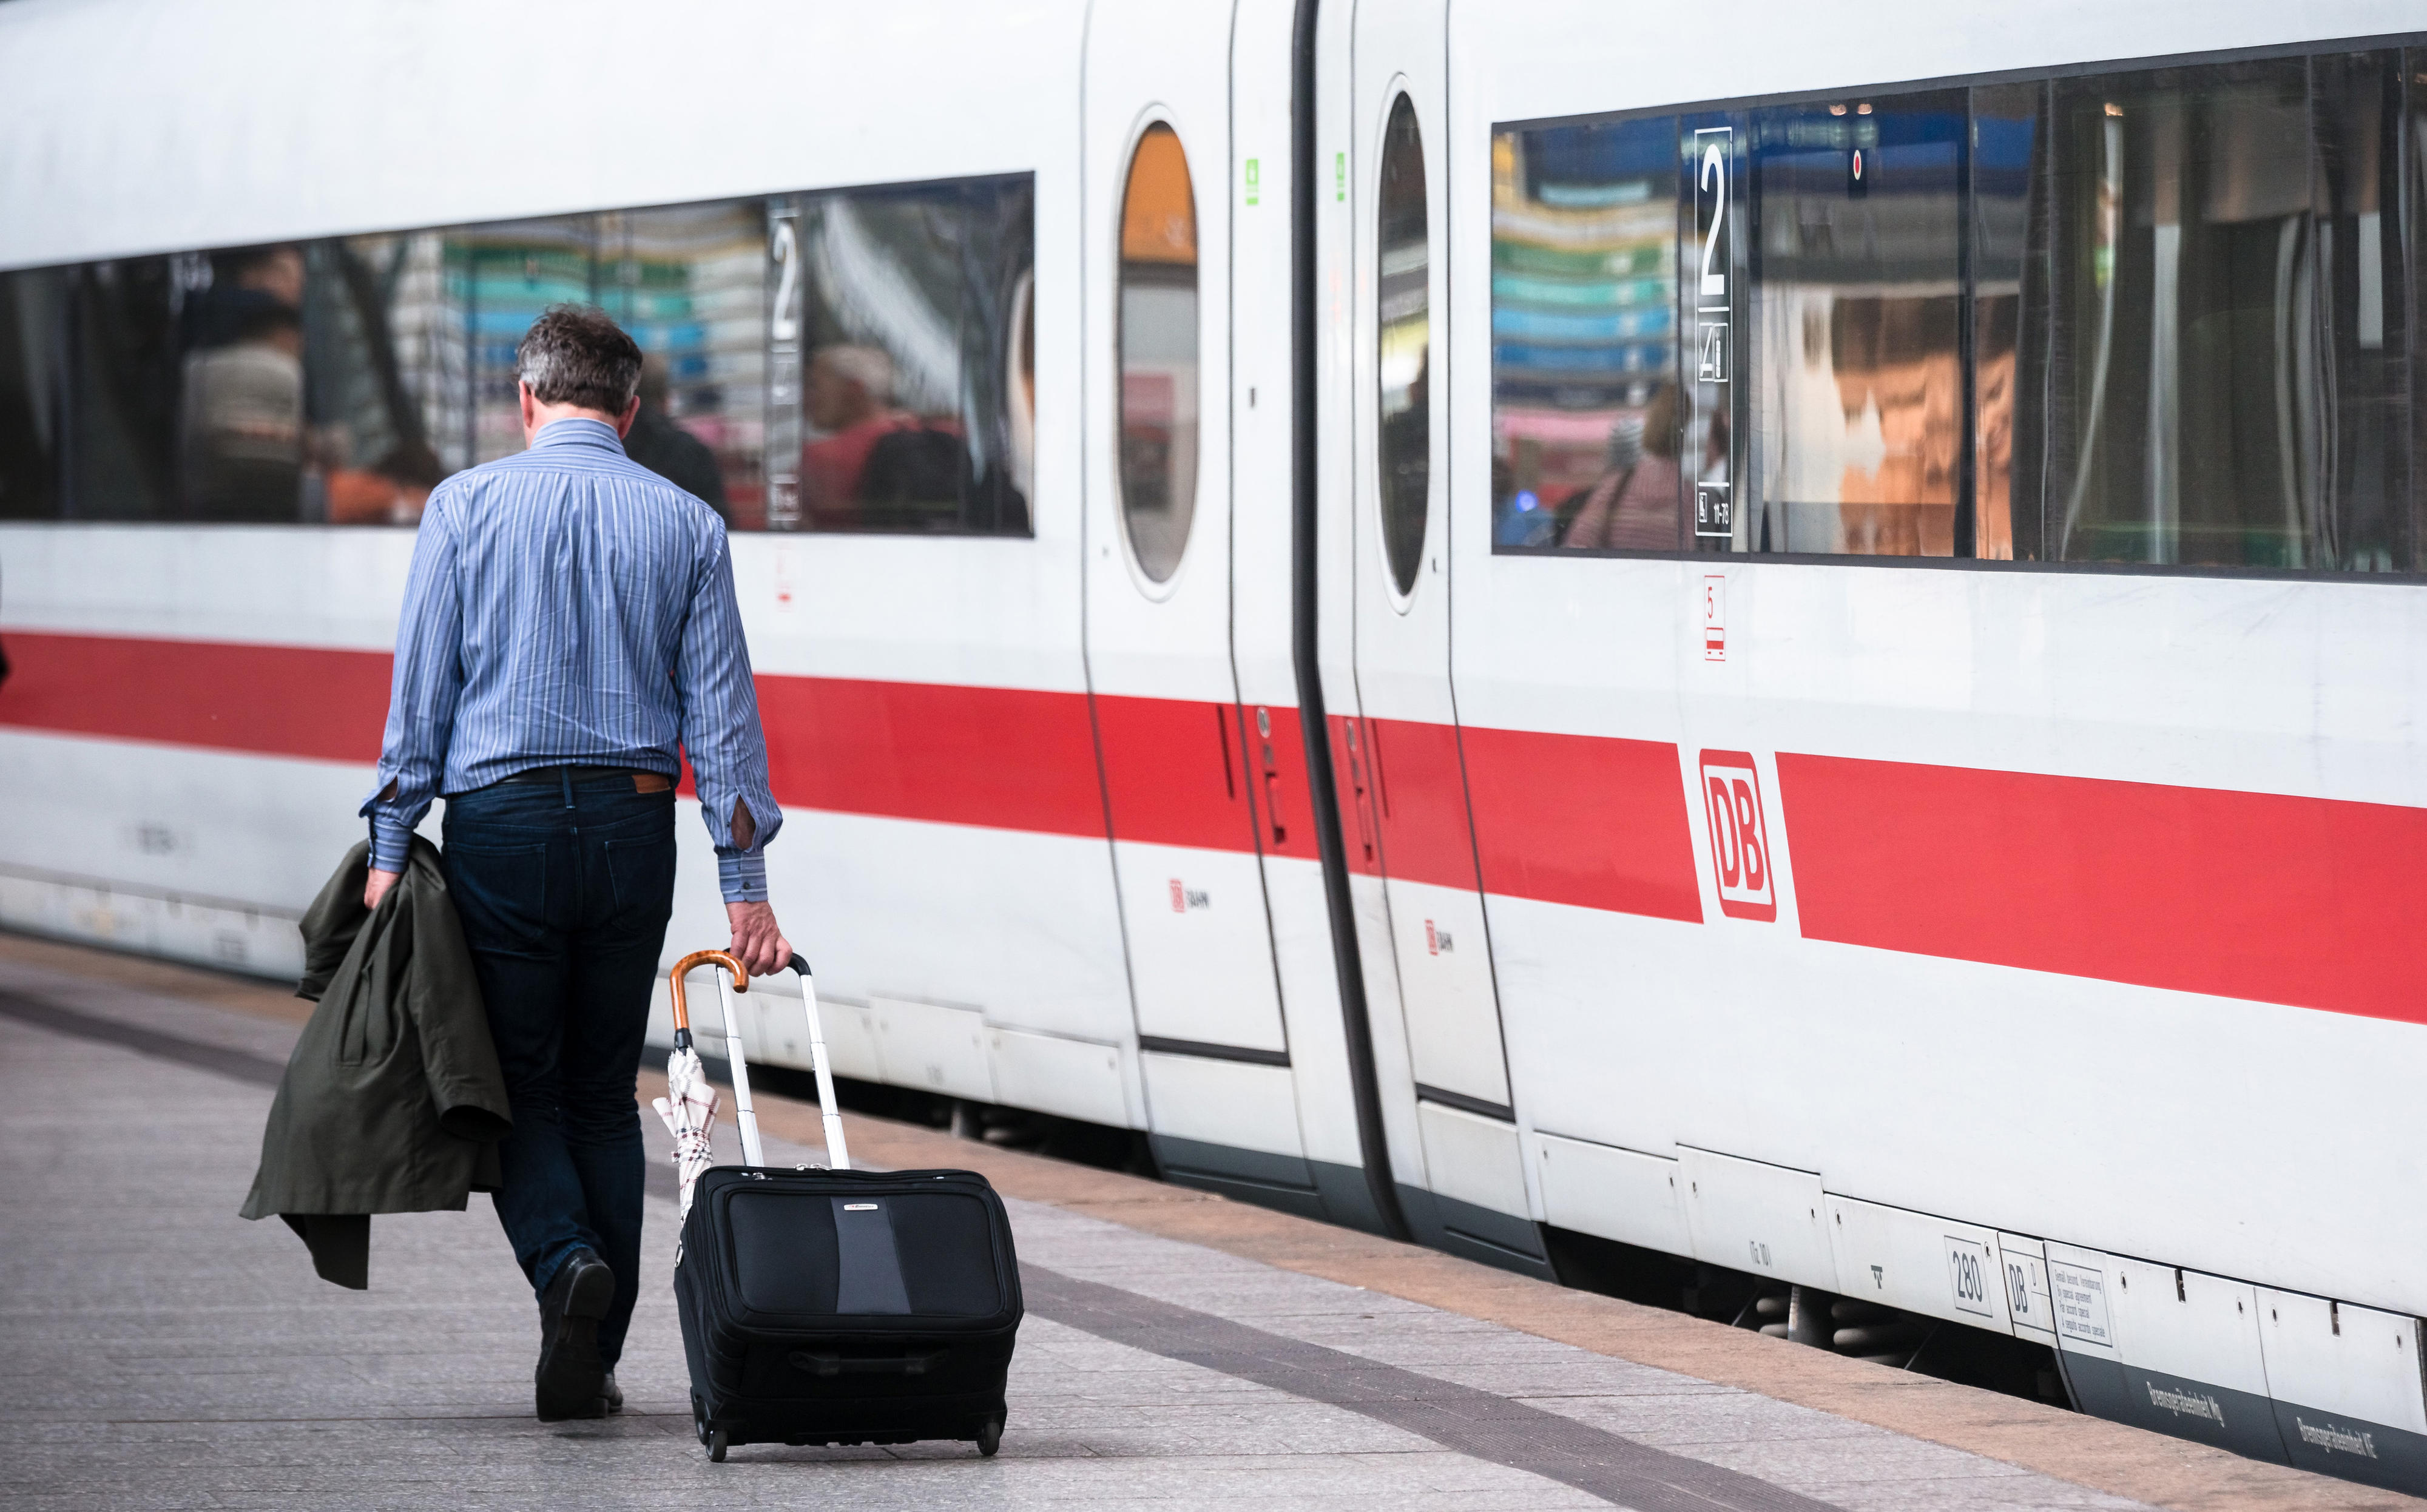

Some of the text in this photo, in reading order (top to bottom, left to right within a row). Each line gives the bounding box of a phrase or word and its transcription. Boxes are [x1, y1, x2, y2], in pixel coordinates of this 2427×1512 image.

[1701, 144, 1724, 295] 2
[772, 223, 797, 340] 2
[1707, 586, 1713, 619] 5
[1707, 775, 1765, 893] DB
[1953, 1250, 1982, 1302] 280
[2008, 1264, 2028, 1313] DB
[2146, 1381, 2213, 1420] Bremsgeräteeinheit
[2296, 1416, 2367, 1457] Bremsgeräteeinheit
